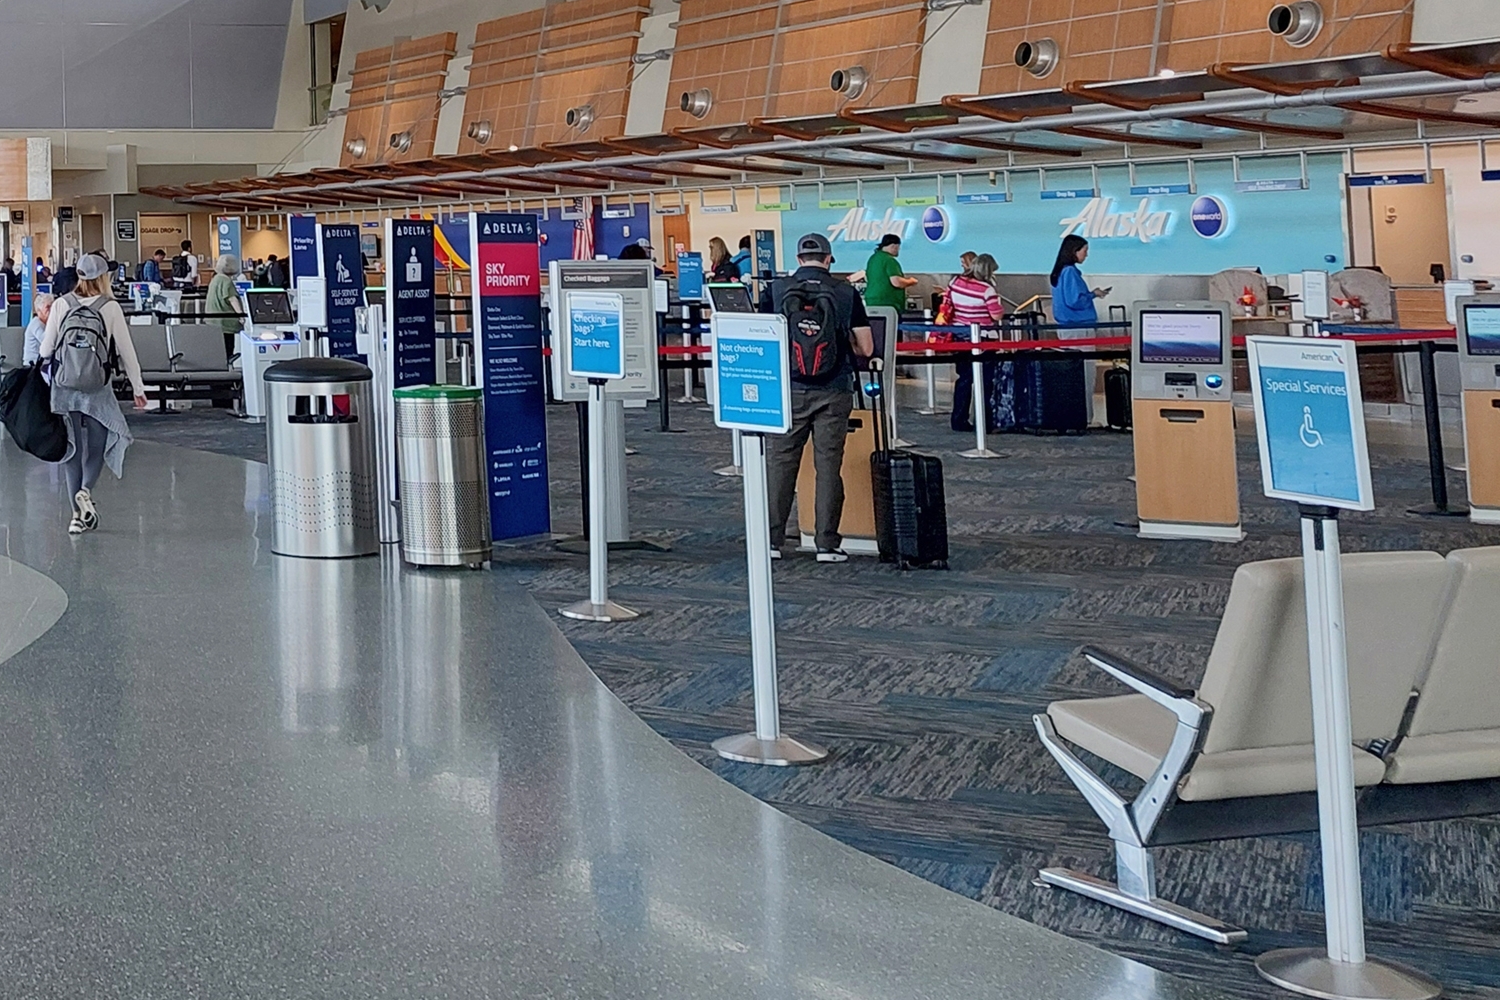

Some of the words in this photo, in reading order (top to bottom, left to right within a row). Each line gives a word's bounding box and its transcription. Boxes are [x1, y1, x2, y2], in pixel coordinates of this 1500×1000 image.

[1059, 197, 1171, 243] Alaska
[1193, 212, 1221, 221] oneworld
[493, 223, 524, 233] DELTA
[828, 207, 910, 242] Alaska
[332, 229, 351, 238] DELTA
[403, 226, 425, 235] DELTA
[758, 246, 771, 260] Drop
[485, 263, 505, 274] SKY
[486, 275, 530, 287] PRIORITY
[331, 289, 358, 298] SELF-SERVICE
[398, 290, 414, 298] AGENT
[415, 289, 430, 297] ASSIST
[334, 298, 344, 306] BAG
[574, 312, 606, 324] Checking
[574, 324, 594, 335] bags?
[574, 338, 593, 347] Start
[593, 338, 610, 348] here.
[720, 344, 733, 352] Not
[734, 345, 764, 356] checking
[720, 354, 739, 363] bags?
[1301, 352, 1333, 361] American
[1266, 378, 1301, 393] Special
[1304, 381, 1346, 396] Services
